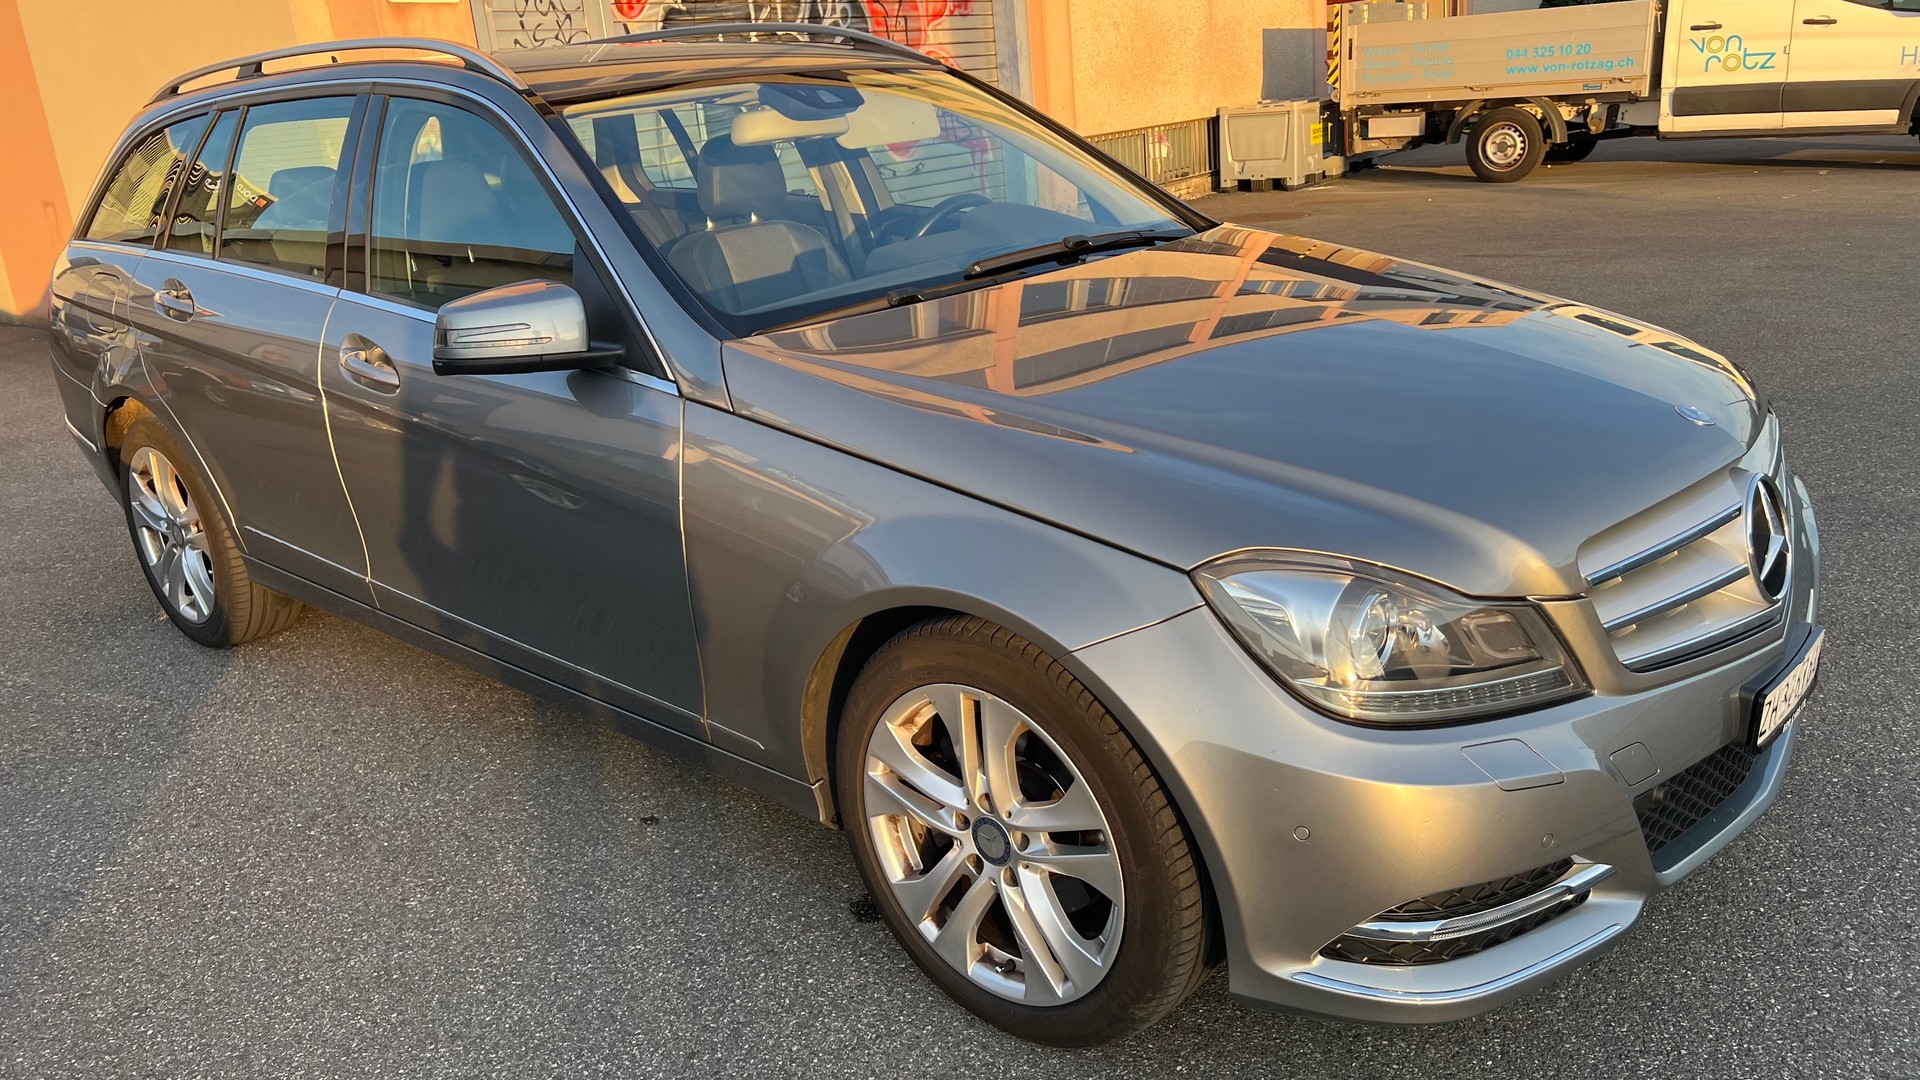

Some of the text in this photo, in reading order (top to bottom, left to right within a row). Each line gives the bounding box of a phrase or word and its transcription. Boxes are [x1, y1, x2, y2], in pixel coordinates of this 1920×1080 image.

[1506, 43, 1592, 60] 044 325 10 20
[1689, 34, 1743, 54] von
[1506, 56, 1635, 75] www.von-rotzag.ch
[1704, 48, 1777, 72] rotz
